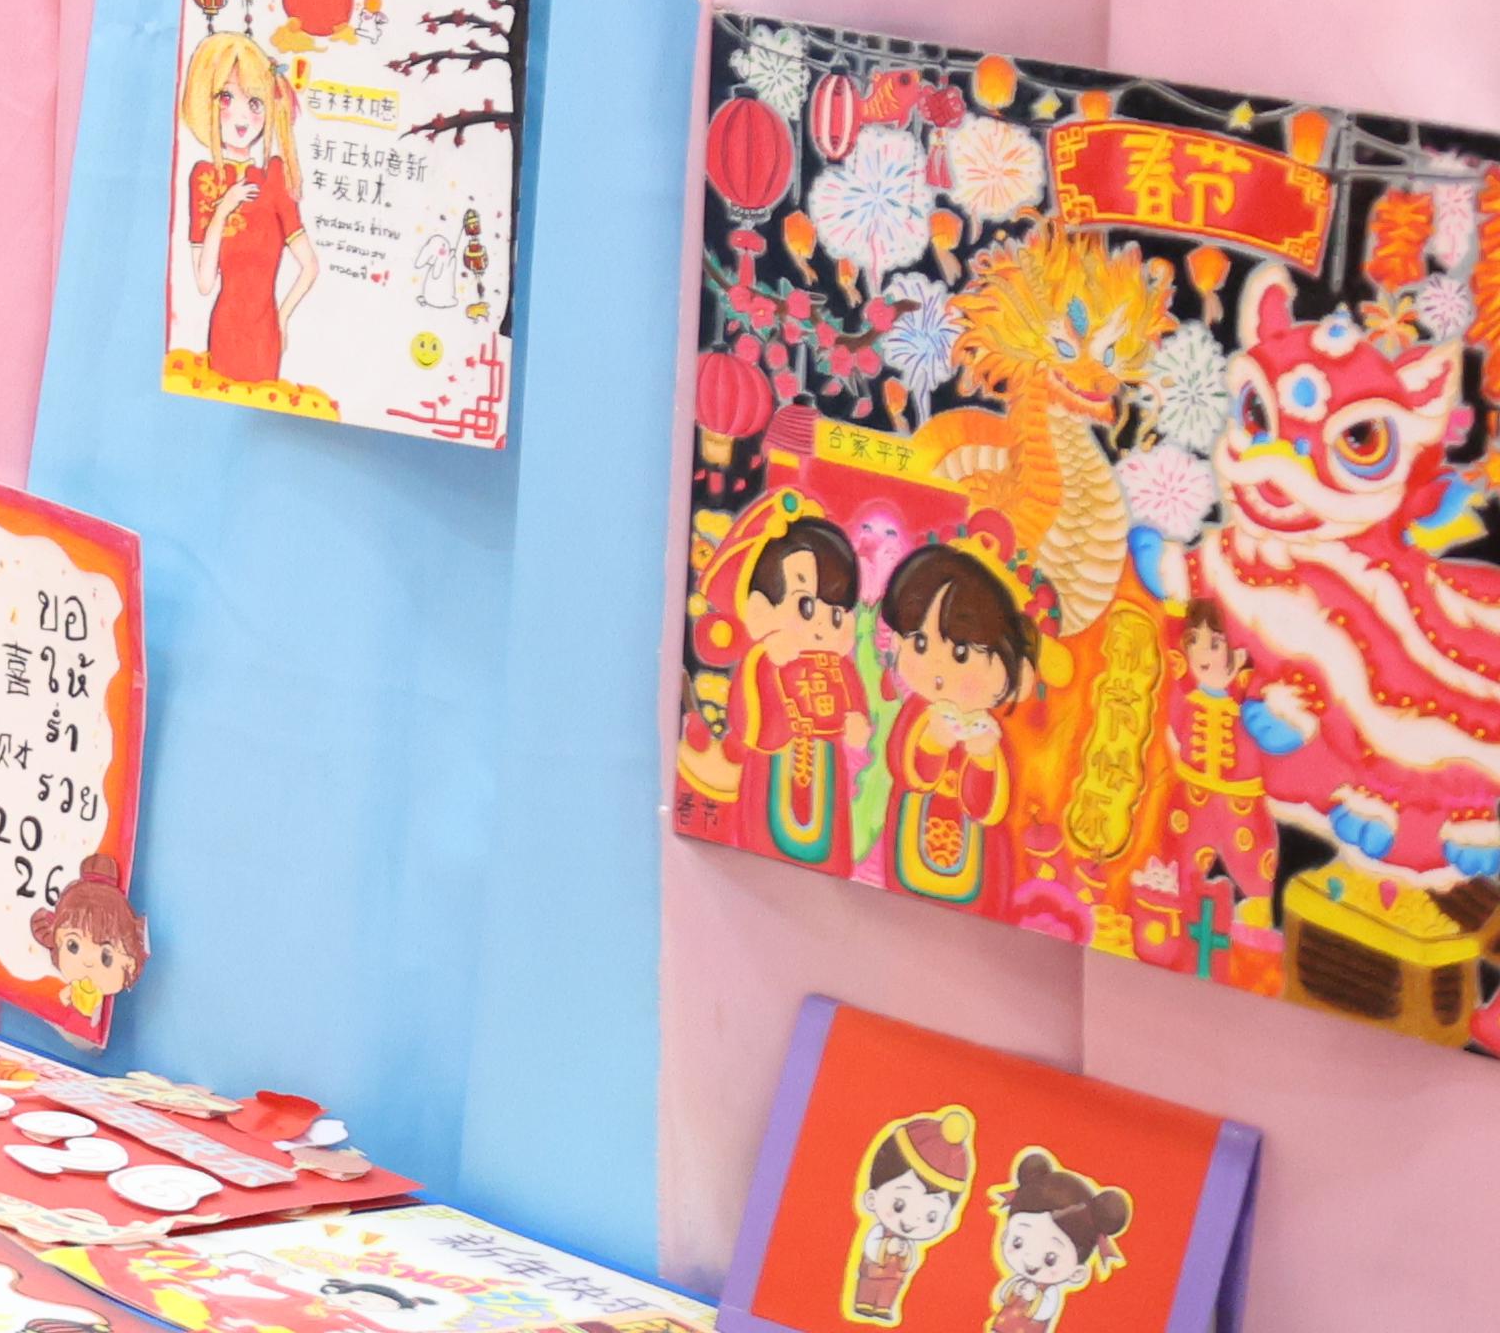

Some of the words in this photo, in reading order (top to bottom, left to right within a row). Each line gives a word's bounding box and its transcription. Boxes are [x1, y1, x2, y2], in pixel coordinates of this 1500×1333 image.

[1121, 132, 1253, 226] 春节
[829, 425, 916, 472] 合家平安
[38, 590, 88, 641] ขอ
[1, 640, 34, 697] 喜
[41, 645, 95, 698] ให้
[38, 774, 98, 822] รวย
[14, 856, 64, 906] 26
